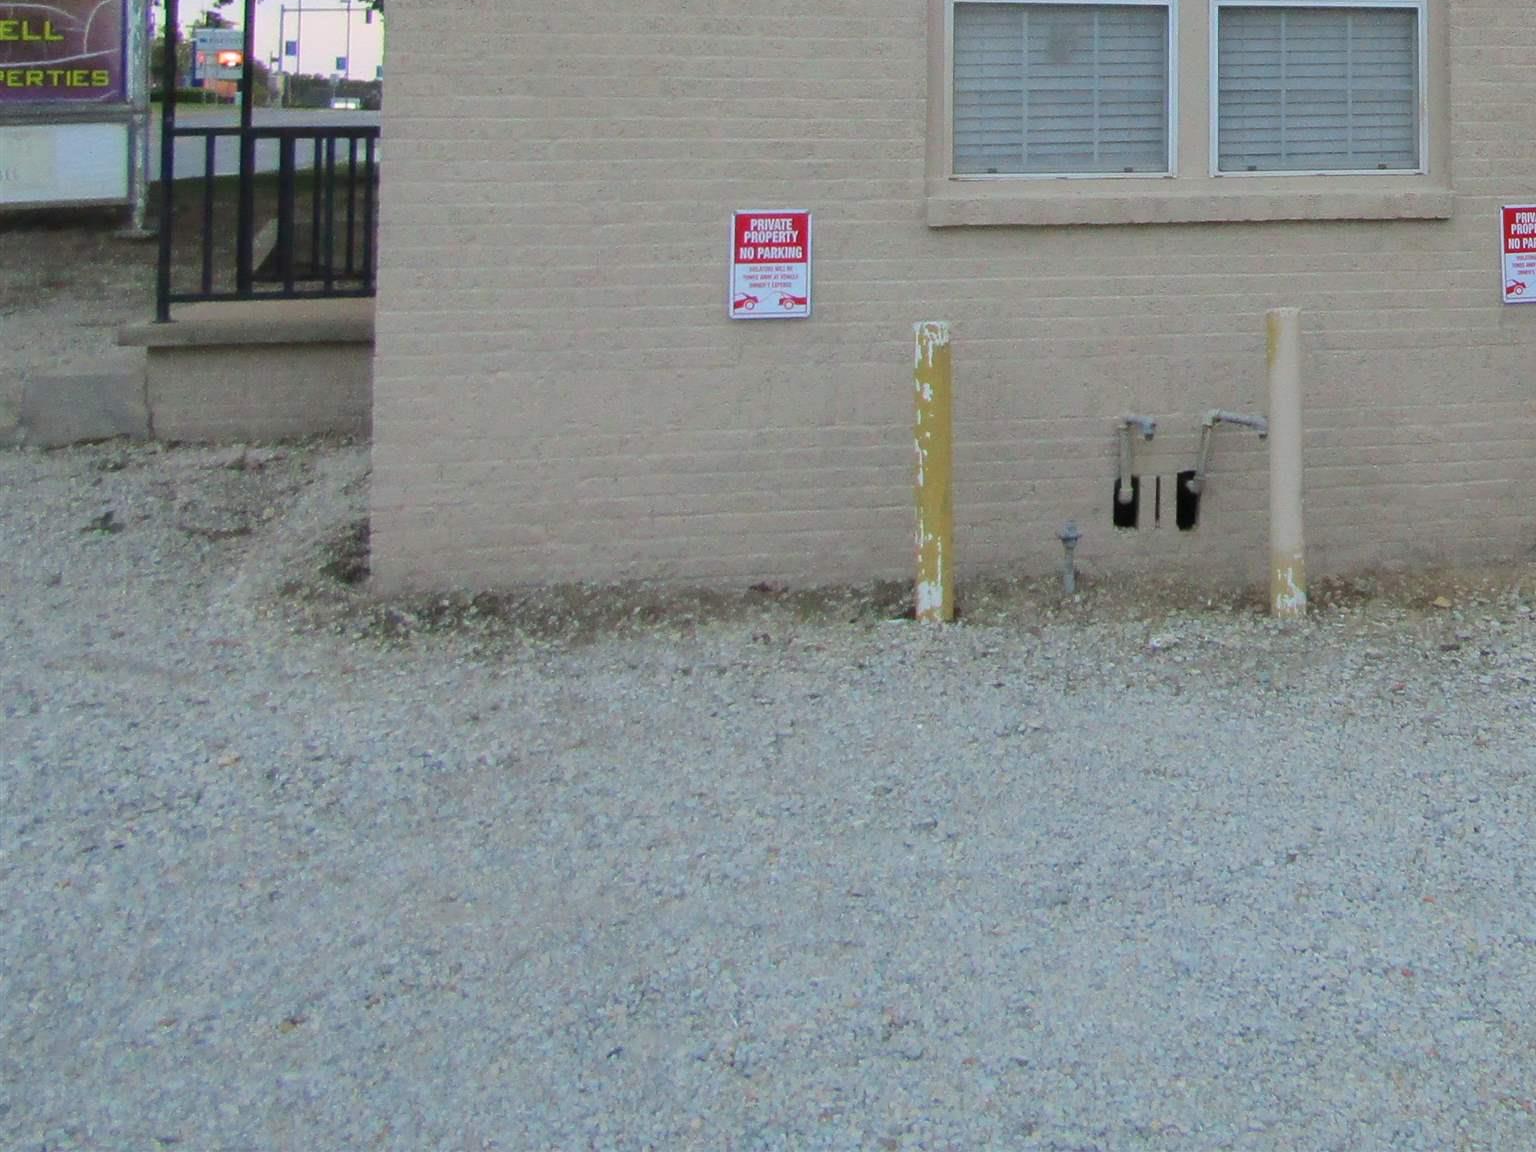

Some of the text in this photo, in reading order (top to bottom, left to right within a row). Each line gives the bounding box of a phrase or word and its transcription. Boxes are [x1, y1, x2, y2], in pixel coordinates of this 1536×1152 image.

[0, 69, 110, 87] ERTIES
[750, 218, 793, 231] PRIVATE
[743, 230, 799, 243] PROPERTY
[1508, 238, 1520, 250] NO
[739, 246, 803, 260] NO PARKING
